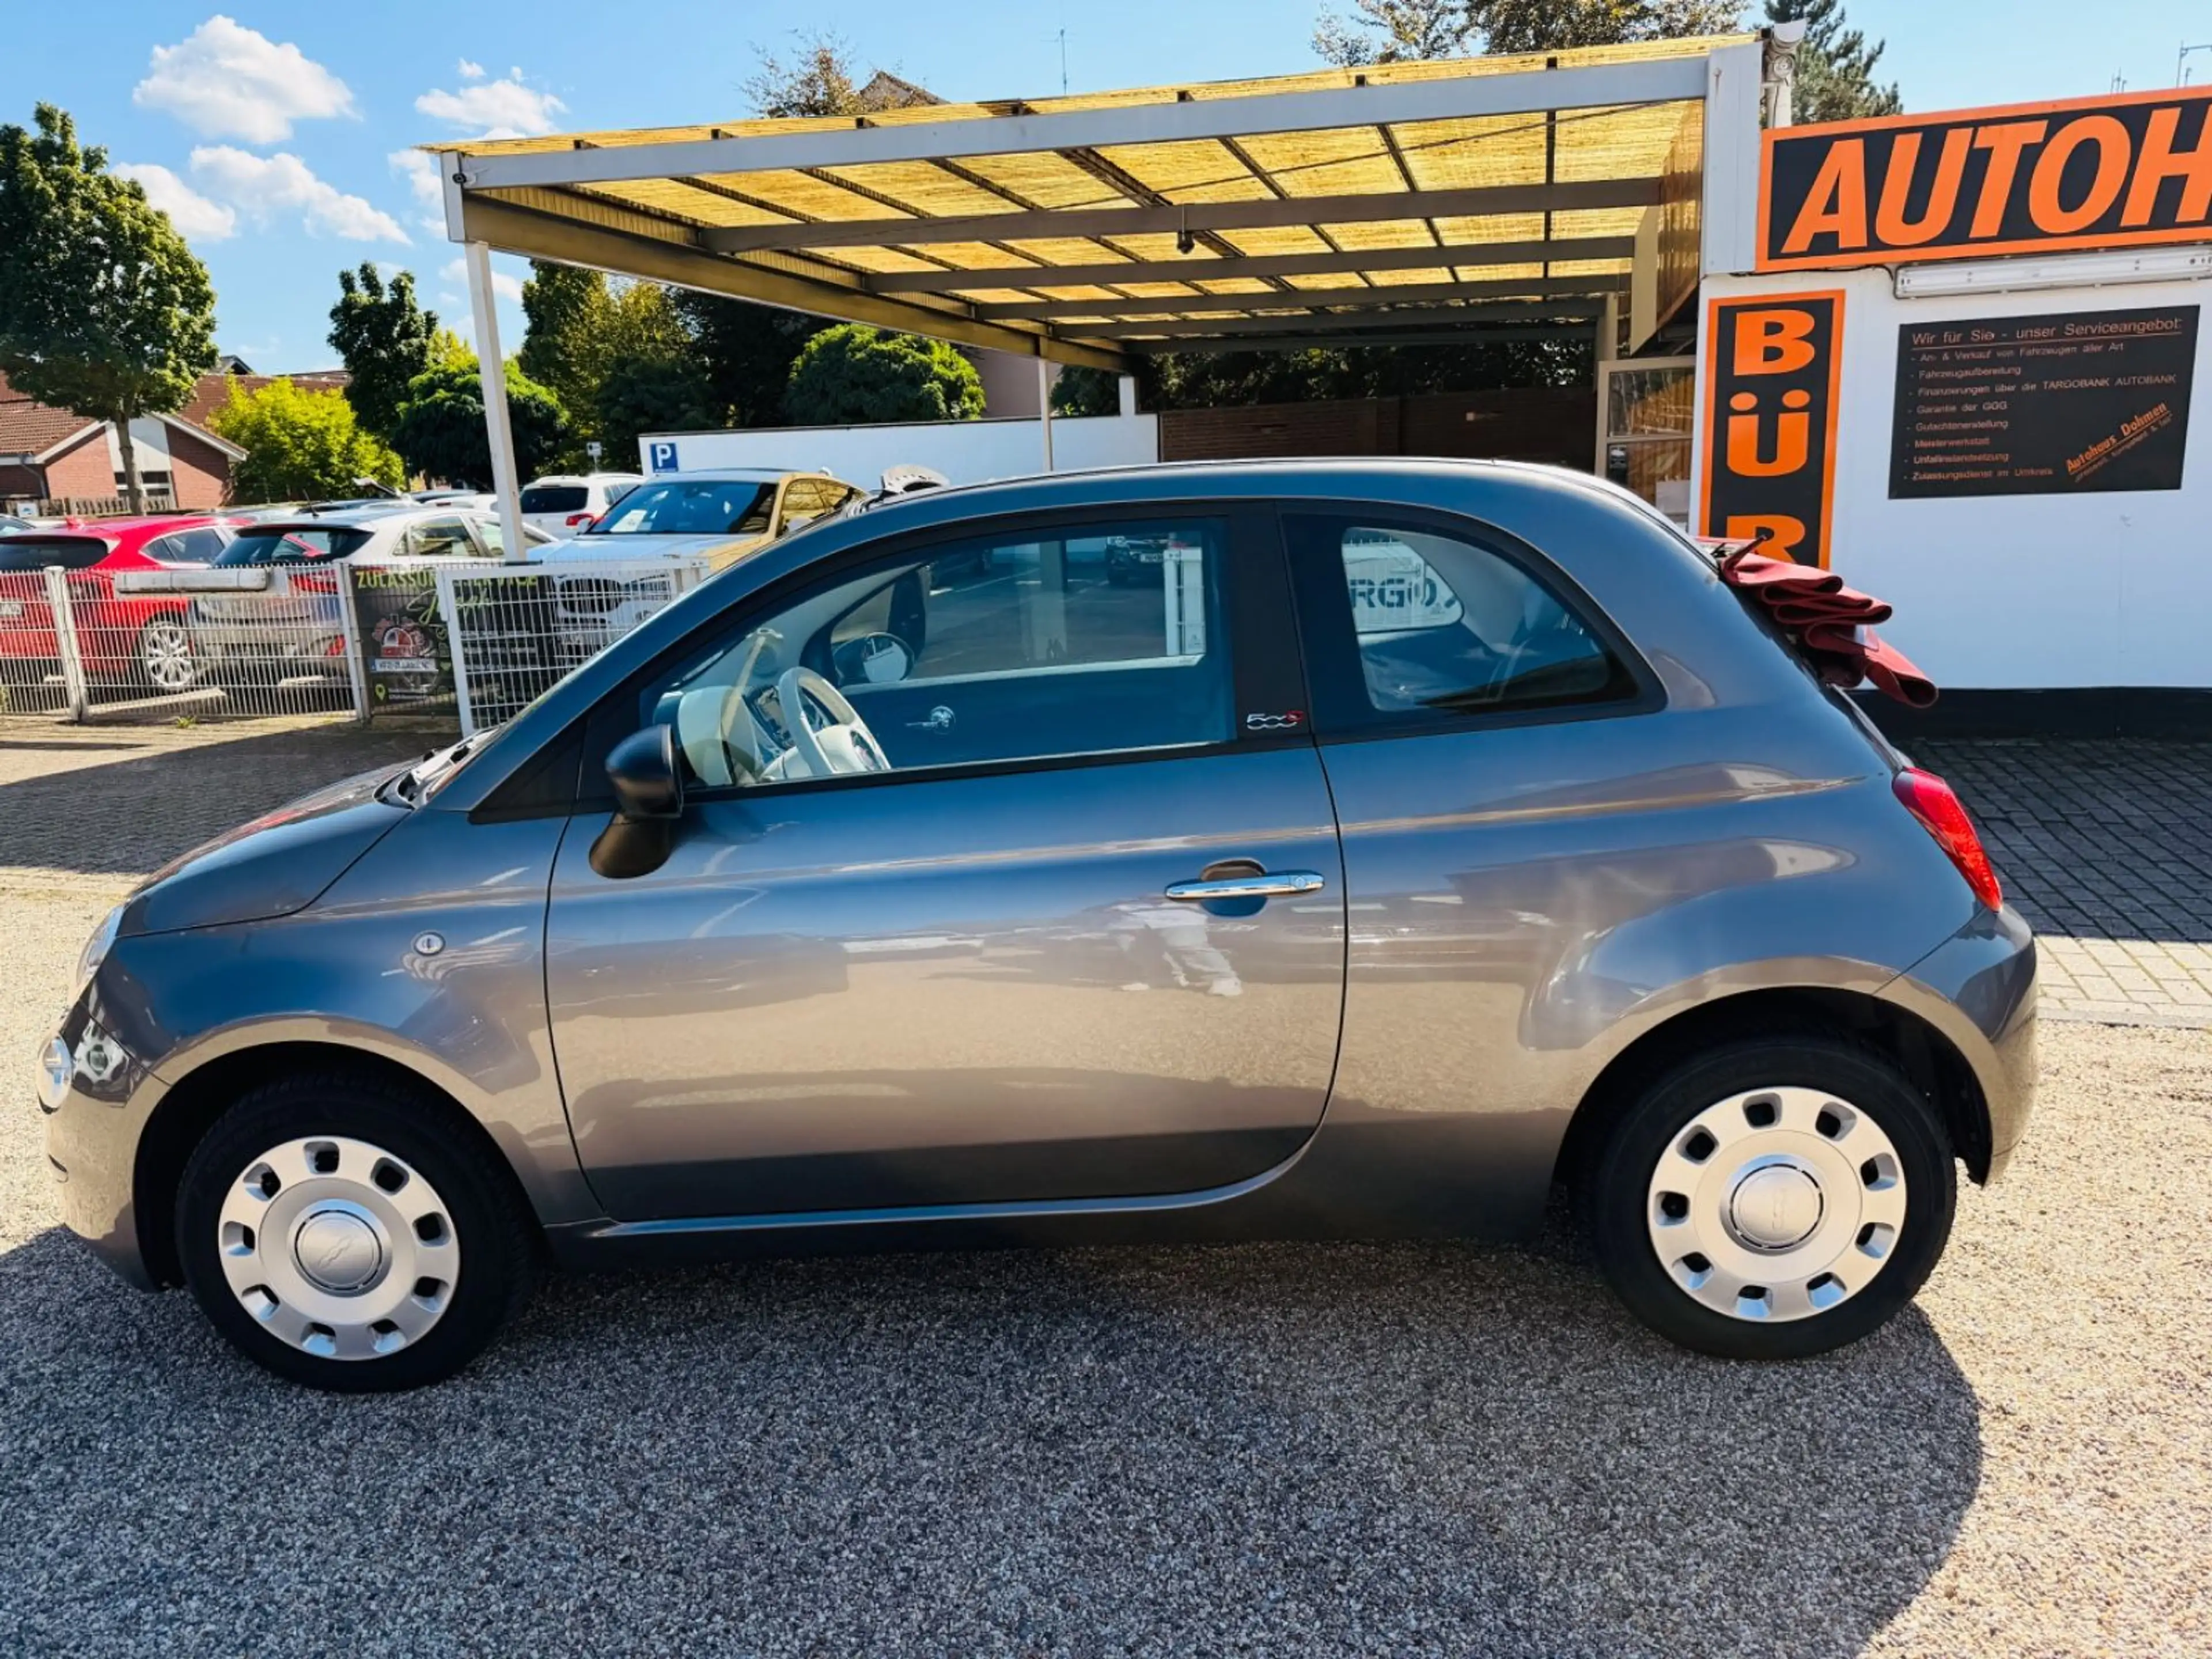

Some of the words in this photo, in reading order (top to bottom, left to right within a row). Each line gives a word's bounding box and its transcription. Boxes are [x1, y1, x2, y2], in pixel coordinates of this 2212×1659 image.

[1781, 104, 2212, 253] AUTOH
[1912, 332, 1936, 344] Wir
[1943, 331, 1963, 344] für
[1971, 329, 1995, 342] Sie
[2016, 326, 2056, 339] unser
[2020, 346, 2077, 358] Fahrzeugen
[2108, 342, 2123, 351] Art
[2066, 434, 2117, 472] Autohaus
[2120, 402, 2168, 437] Dohmen
[656, 444, 671, 468] P
